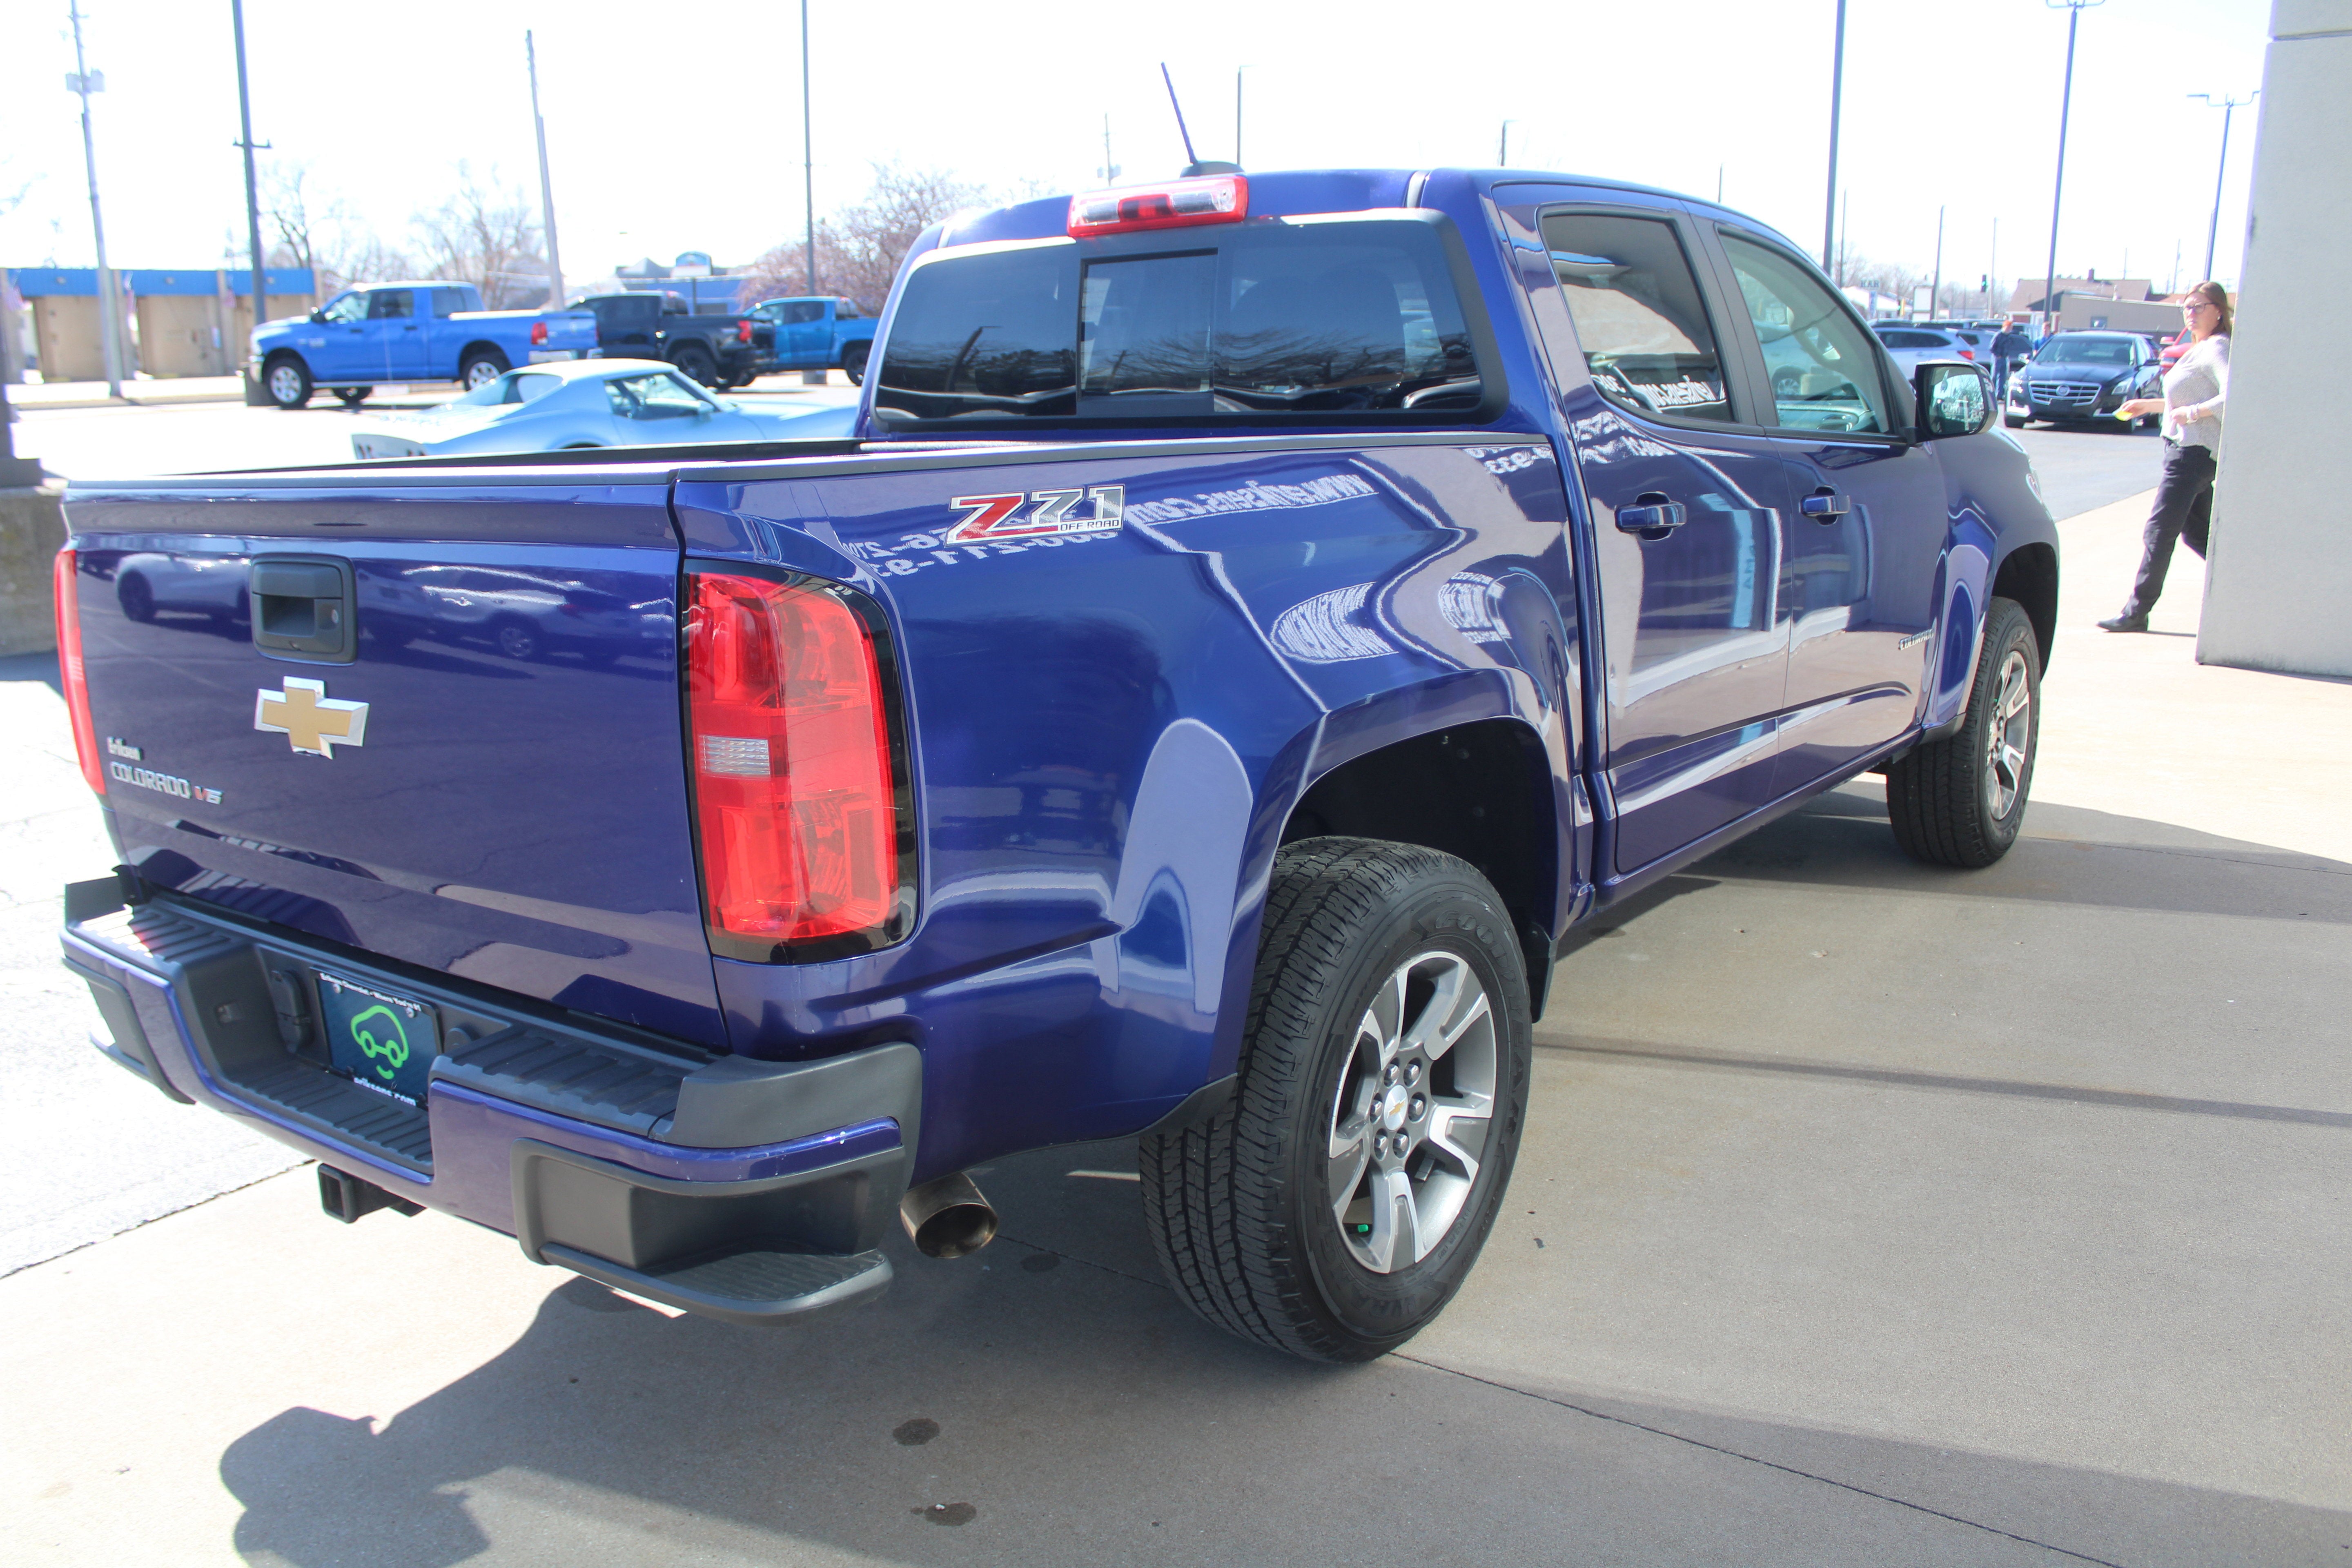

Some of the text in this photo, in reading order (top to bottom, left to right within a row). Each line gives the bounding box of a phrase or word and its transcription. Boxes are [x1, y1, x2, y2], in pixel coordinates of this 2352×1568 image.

[945, 484, 1125, 547] Z71
[1060, 520, 1119, 531] OFF ROAD
[1899, 629, 1934, 650] COLORADO
[110, 761, 223, 805] COLORADO V6
[1435, 909, 1524, 1136] GOODYEAR
